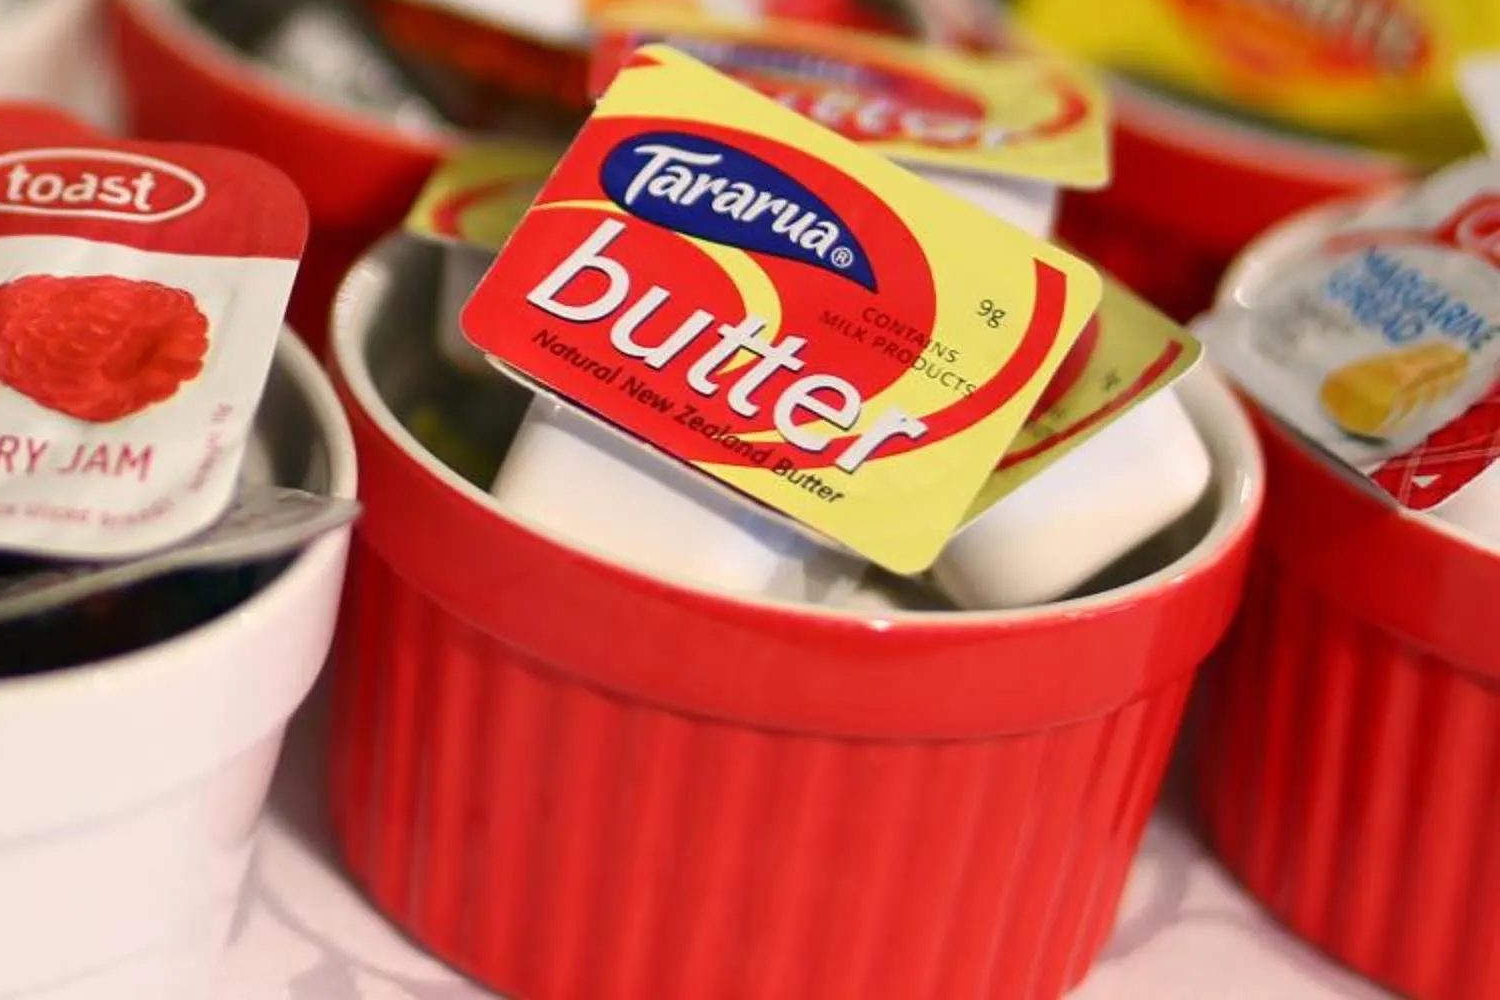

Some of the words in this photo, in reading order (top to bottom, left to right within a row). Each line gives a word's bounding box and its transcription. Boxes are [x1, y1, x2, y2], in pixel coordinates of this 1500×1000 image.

[5, 164, 156, 212] toast
[861, 306, 961, 364] CONTAINS
[977, 299, 1007, 329] 9g
[526, 218, 929, 474] butter
[821, 310, 869, 343] MILK
[872, 337, 977, 399] PRODUCTS
[532, 329, 616, 385] Natural
[620, 376, 673, 415] New
[674, 405, 768, 467] Zealand
[772, 457, 845, 505] Butter
[57, 443, 153, 481] JAM
